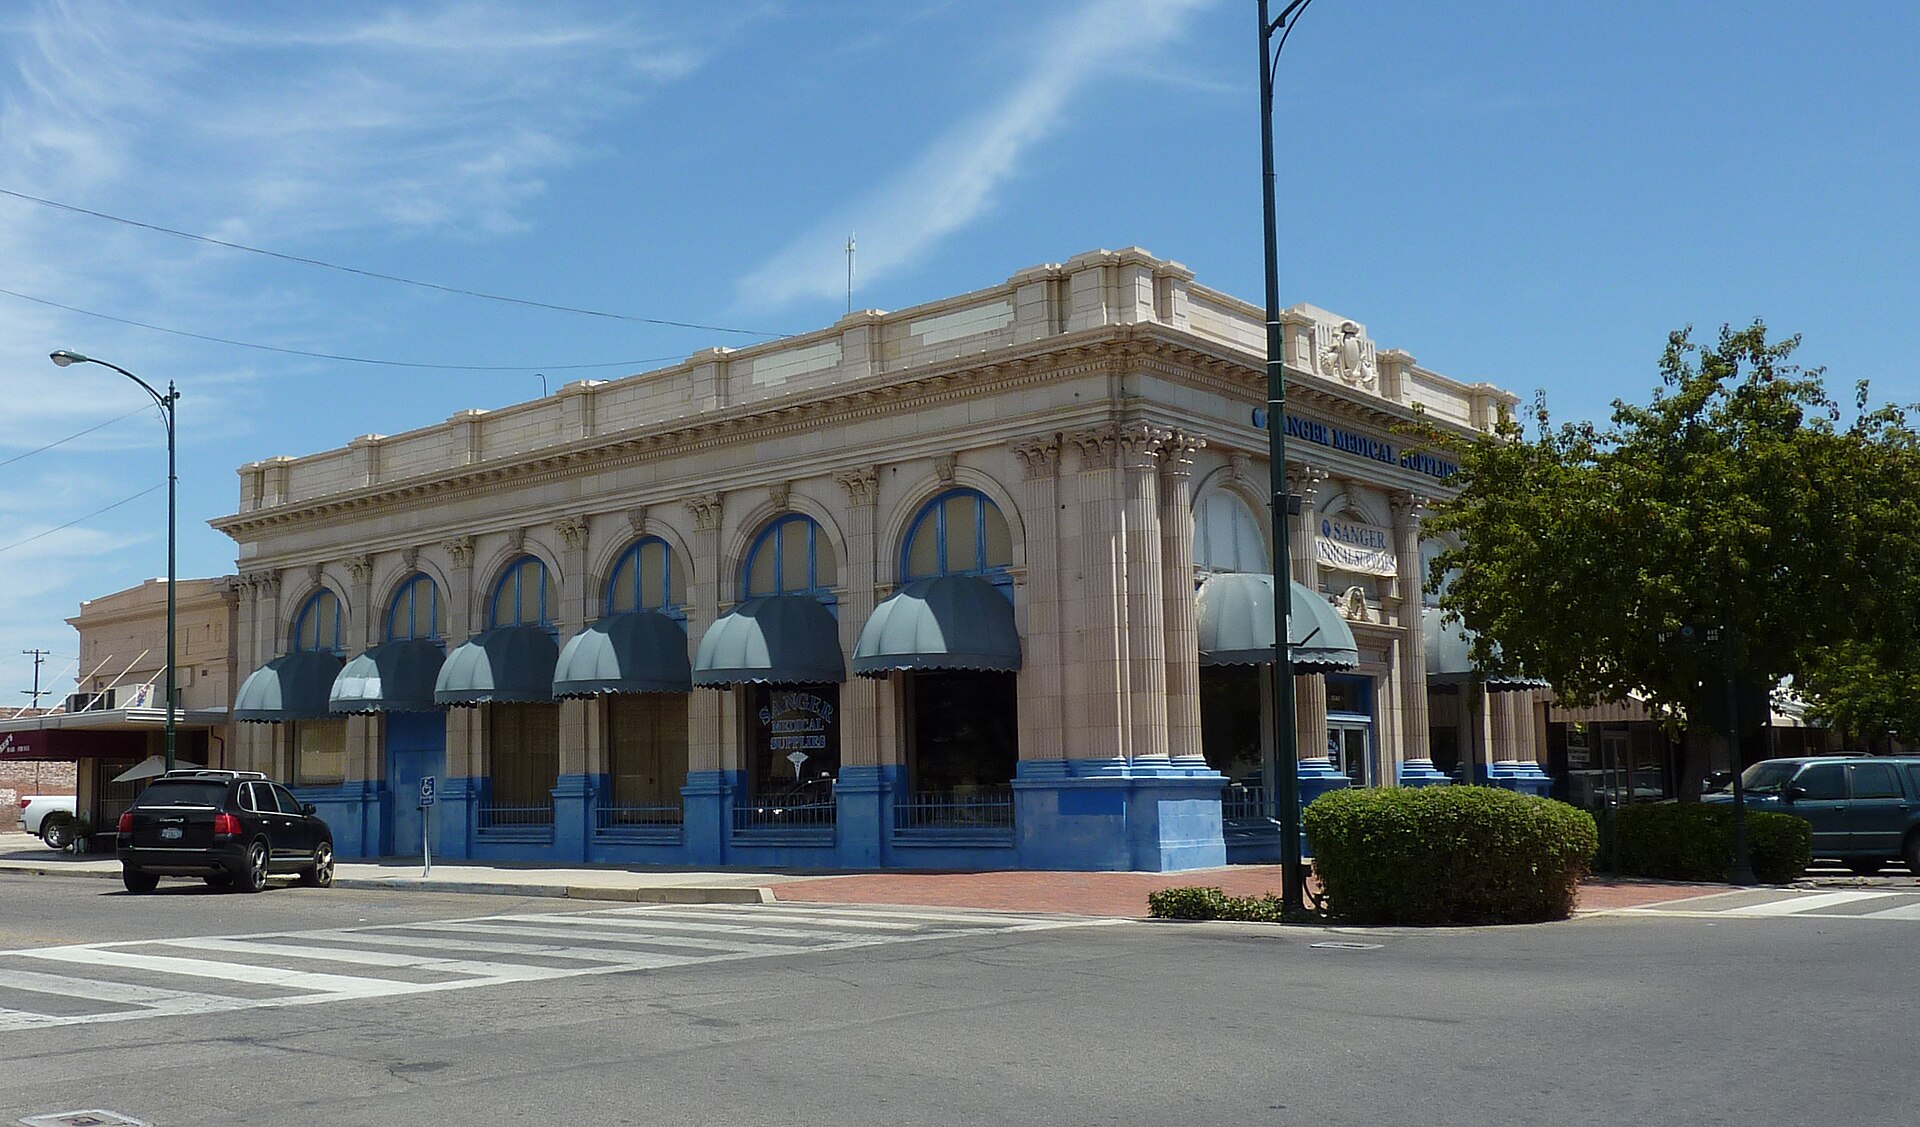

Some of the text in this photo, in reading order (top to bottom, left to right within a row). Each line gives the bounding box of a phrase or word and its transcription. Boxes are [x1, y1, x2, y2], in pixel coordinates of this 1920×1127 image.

[1267, 413, 1330, 446] ANGER
[1332, 428, 1396, 465] MEDICAL
[1334, 522, 1386, 549] SANGER
[759, 693, 834, 725] SANGER
[771, 719, 824, 733] MEDICAL
[770, 735, 826, 750] SUPPLIES
